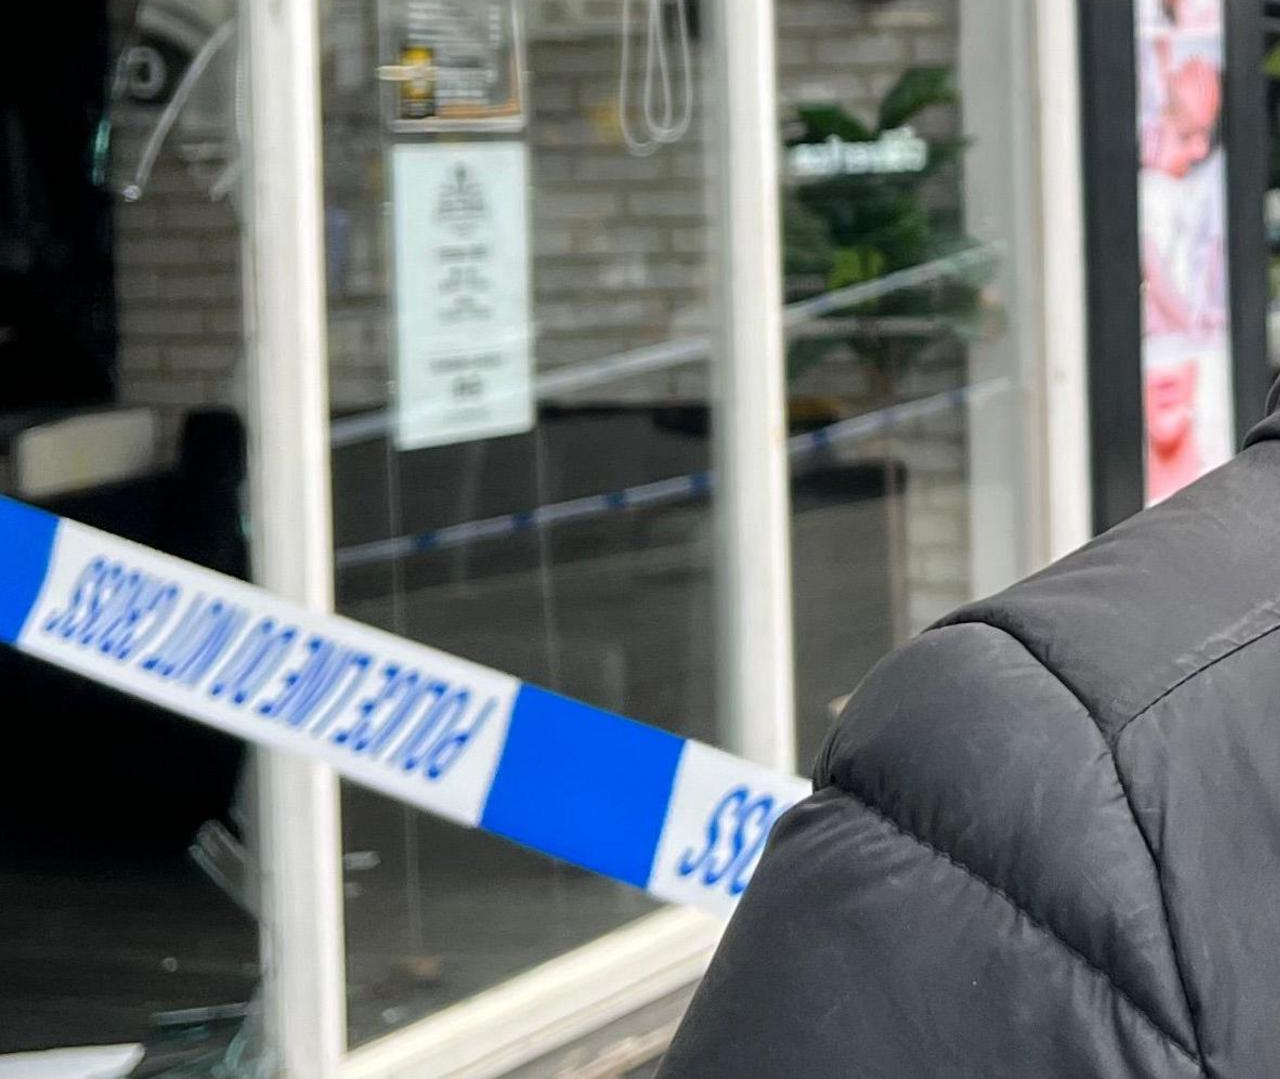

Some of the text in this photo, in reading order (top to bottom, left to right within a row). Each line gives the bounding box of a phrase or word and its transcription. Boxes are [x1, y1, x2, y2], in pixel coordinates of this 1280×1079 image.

[39, 556, 500, 783] POLICE LINE DO NOT CROSS
